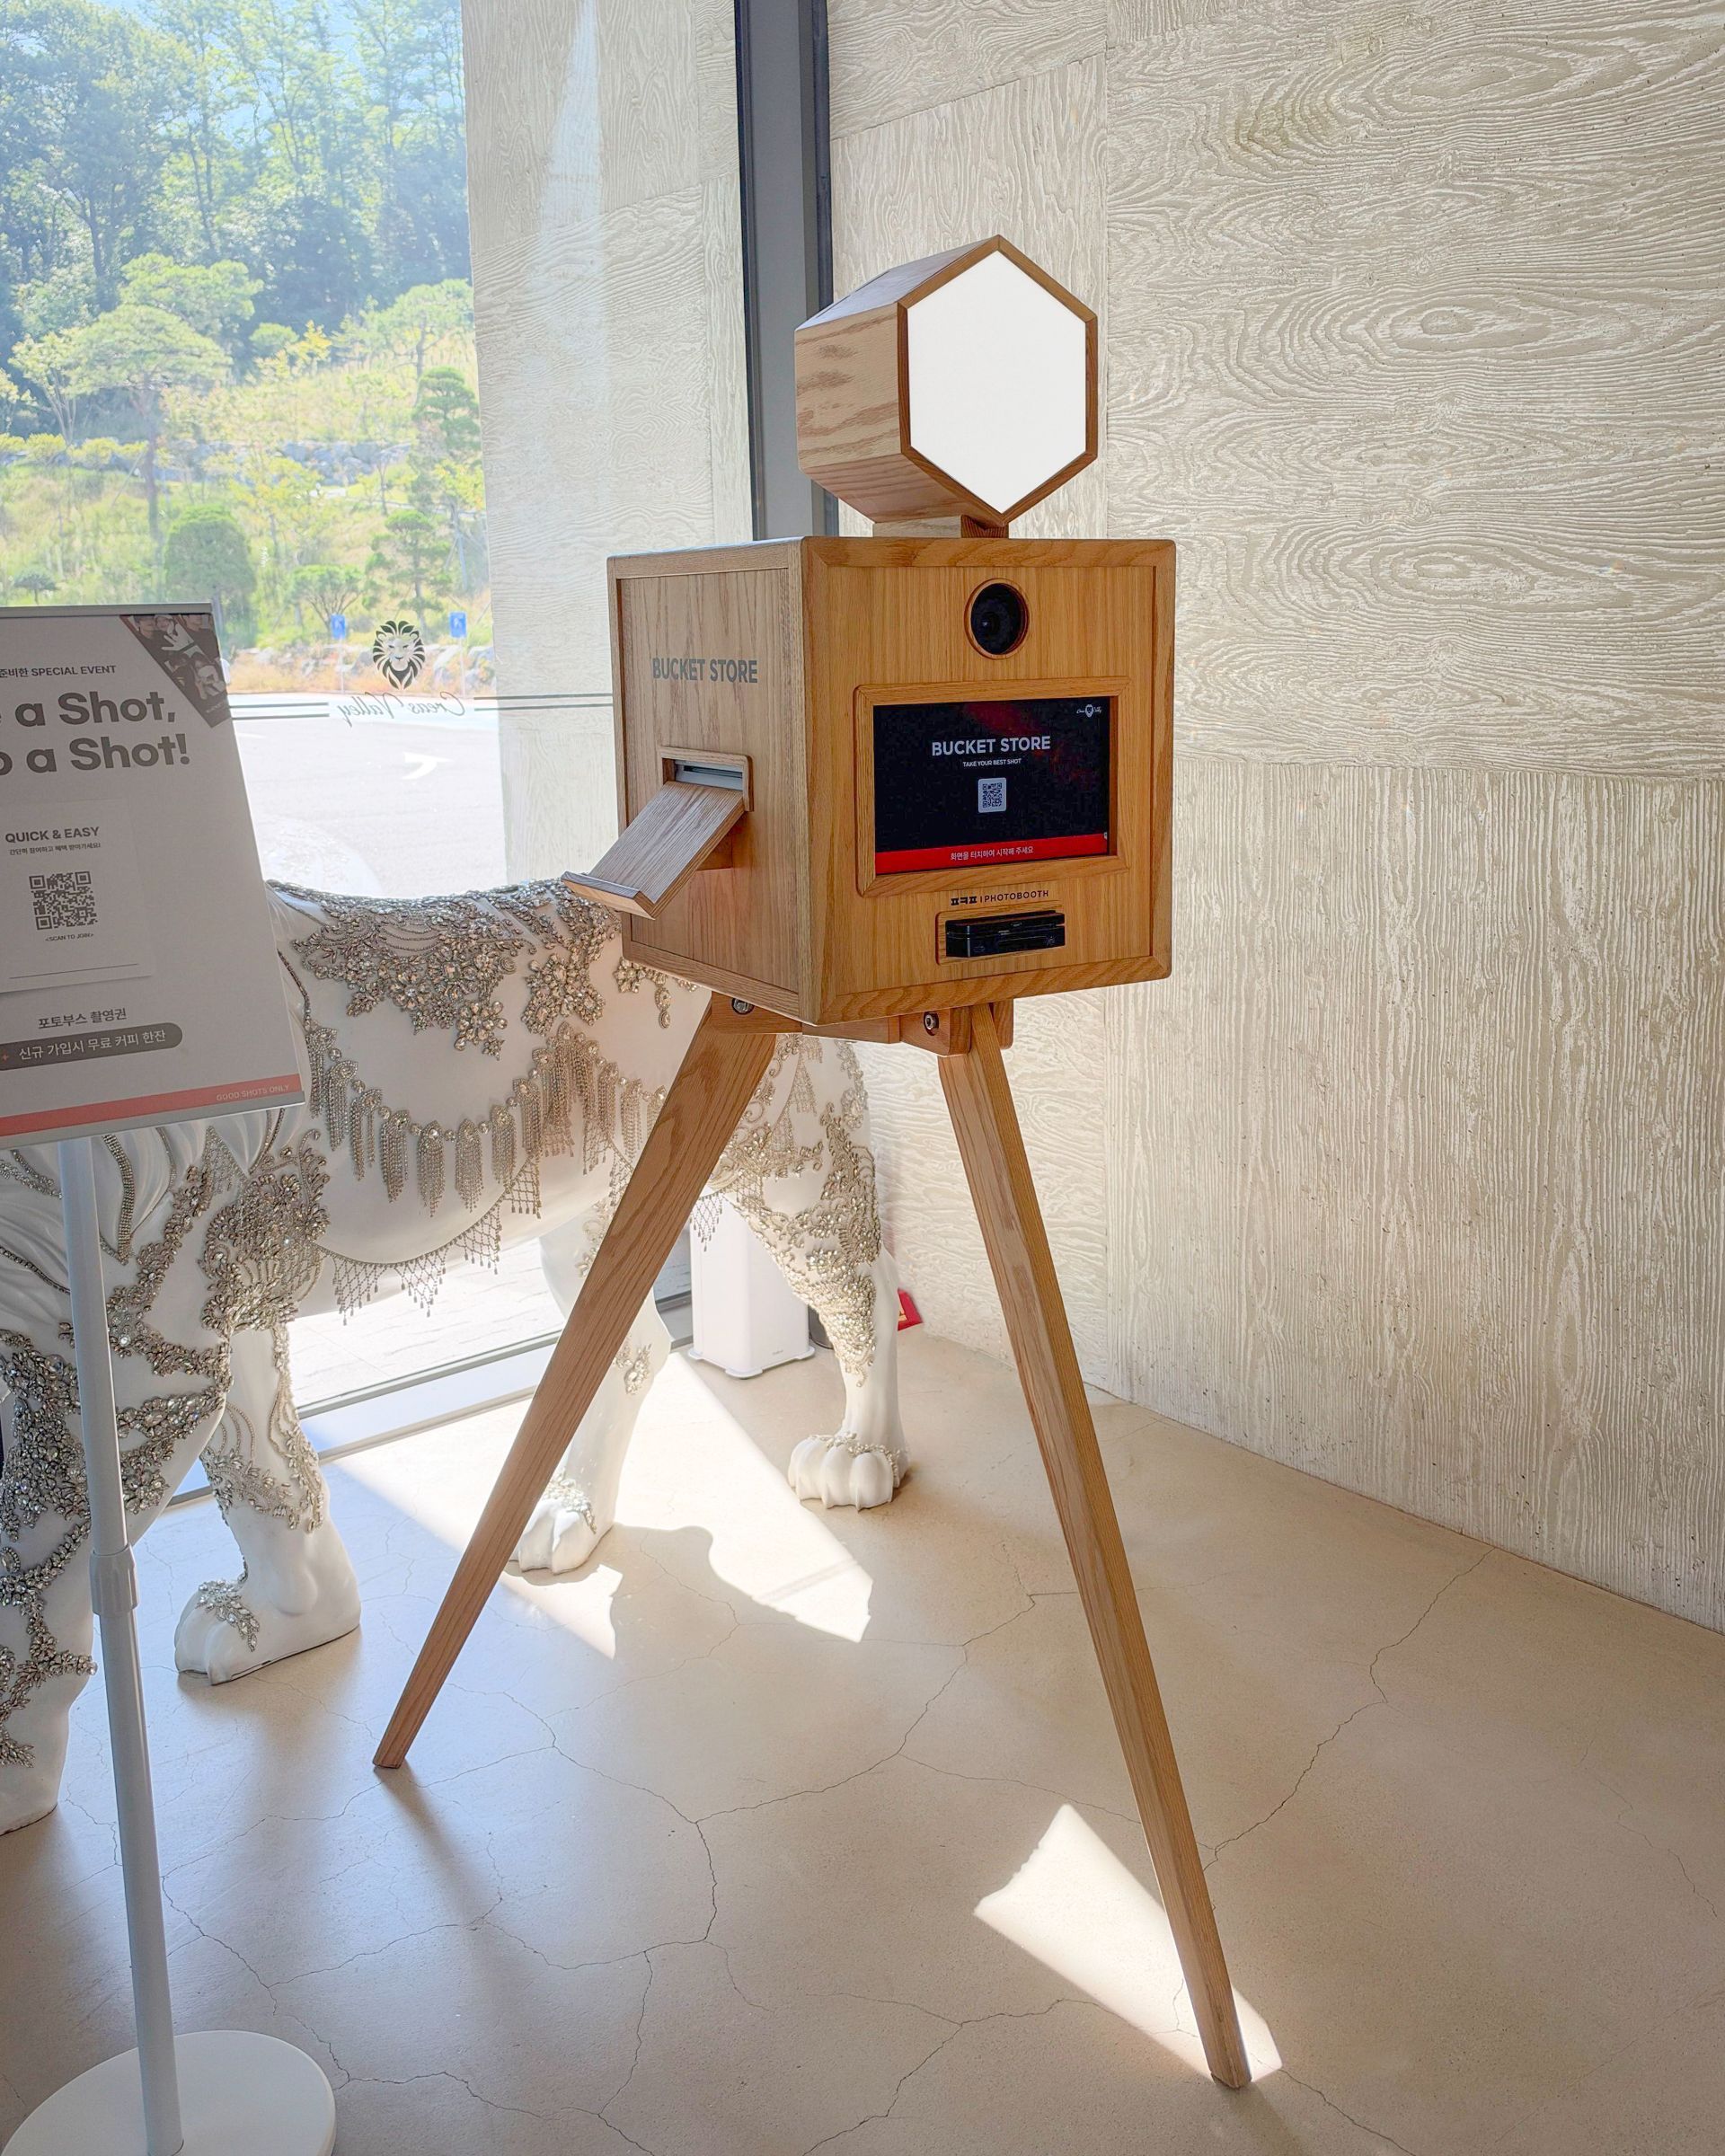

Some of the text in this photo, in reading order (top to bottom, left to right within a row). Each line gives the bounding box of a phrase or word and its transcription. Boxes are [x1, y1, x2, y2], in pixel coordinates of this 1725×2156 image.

[31, 667, 78, 676] SPECIAL
[80, 665, 117, 675] EVENT
[652, 658, 758, 683] BUCKET STORE
[15, 702, 46, 727] a
[26, 748, 58, 773] a
[69, 733, 190, 771] Shot!
[932, 736, 1051, 756] BUCKET STORE
[5, 826, 100, 844] QUICK & EASY
[951, 845, 1034, 861] 화면을 터치하여 시작해 주세요
[985, 890, 1049, 903] PHOTOBOOTH
[38, 1008, 127, 1029] 포토부스 촬영권
[19, 1046, 44, 1060] 신규
[48, 1040, 84, 1056] 가입시
[88, 1037, 111, 1051] 무료
[115, 1033, 139, 1047] 커피
[143, 1029, 166, 1043] 한잔
[217, 1084, 288, 1100] GOOD SHOTS ONLY
